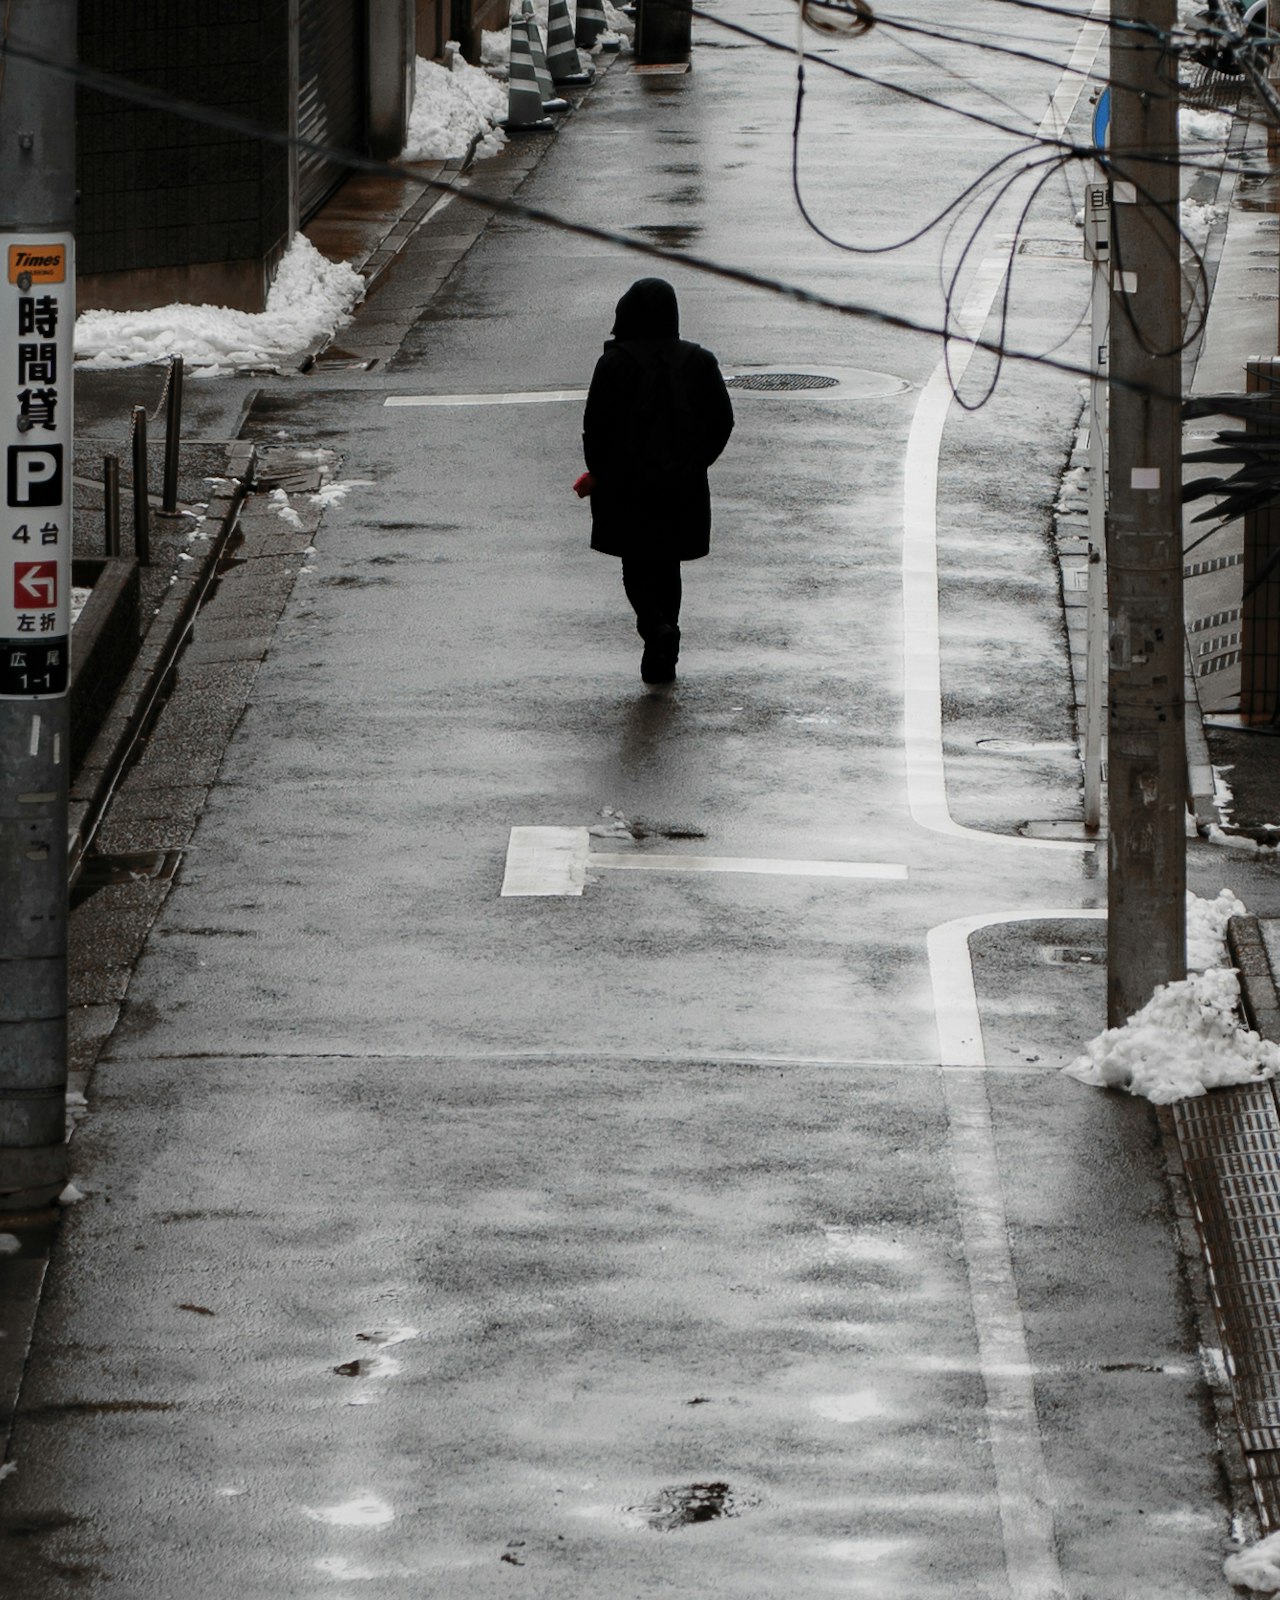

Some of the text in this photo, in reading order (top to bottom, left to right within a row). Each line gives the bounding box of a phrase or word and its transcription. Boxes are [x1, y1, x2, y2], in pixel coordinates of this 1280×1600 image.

[15, 252, 61, 267] Times
[18, 295, 58, 432] 時間貸
[16, 450, 57, 502] P
[17, 612, 56, 632] 左折
[20, 673, 51, 689] 1-1
